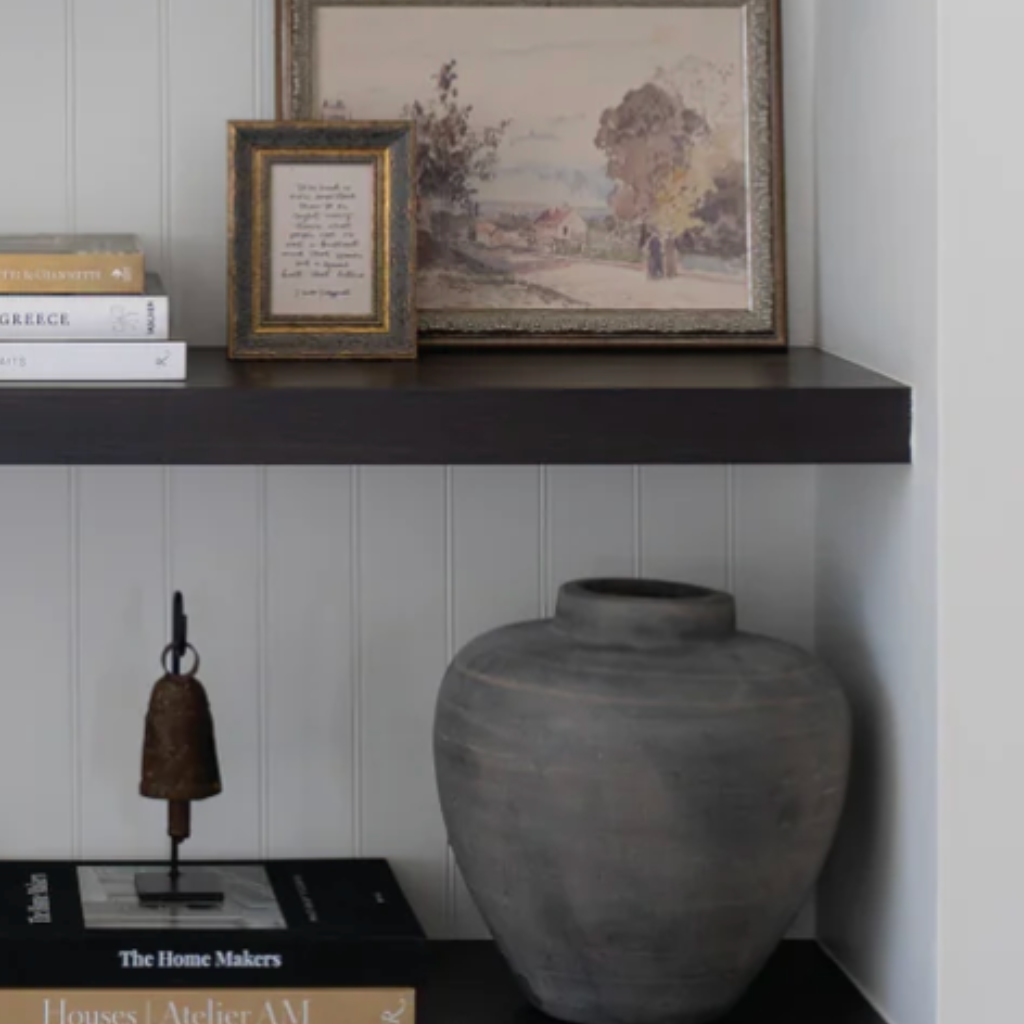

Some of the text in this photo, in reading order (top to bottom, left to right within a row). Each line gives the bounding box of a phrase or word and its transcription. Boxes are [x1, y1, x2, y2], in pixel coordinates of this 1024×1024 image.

[118, 949, 282, 967] The Home Makers
[42, 997, 310, 1024] Houses Atelier AM
